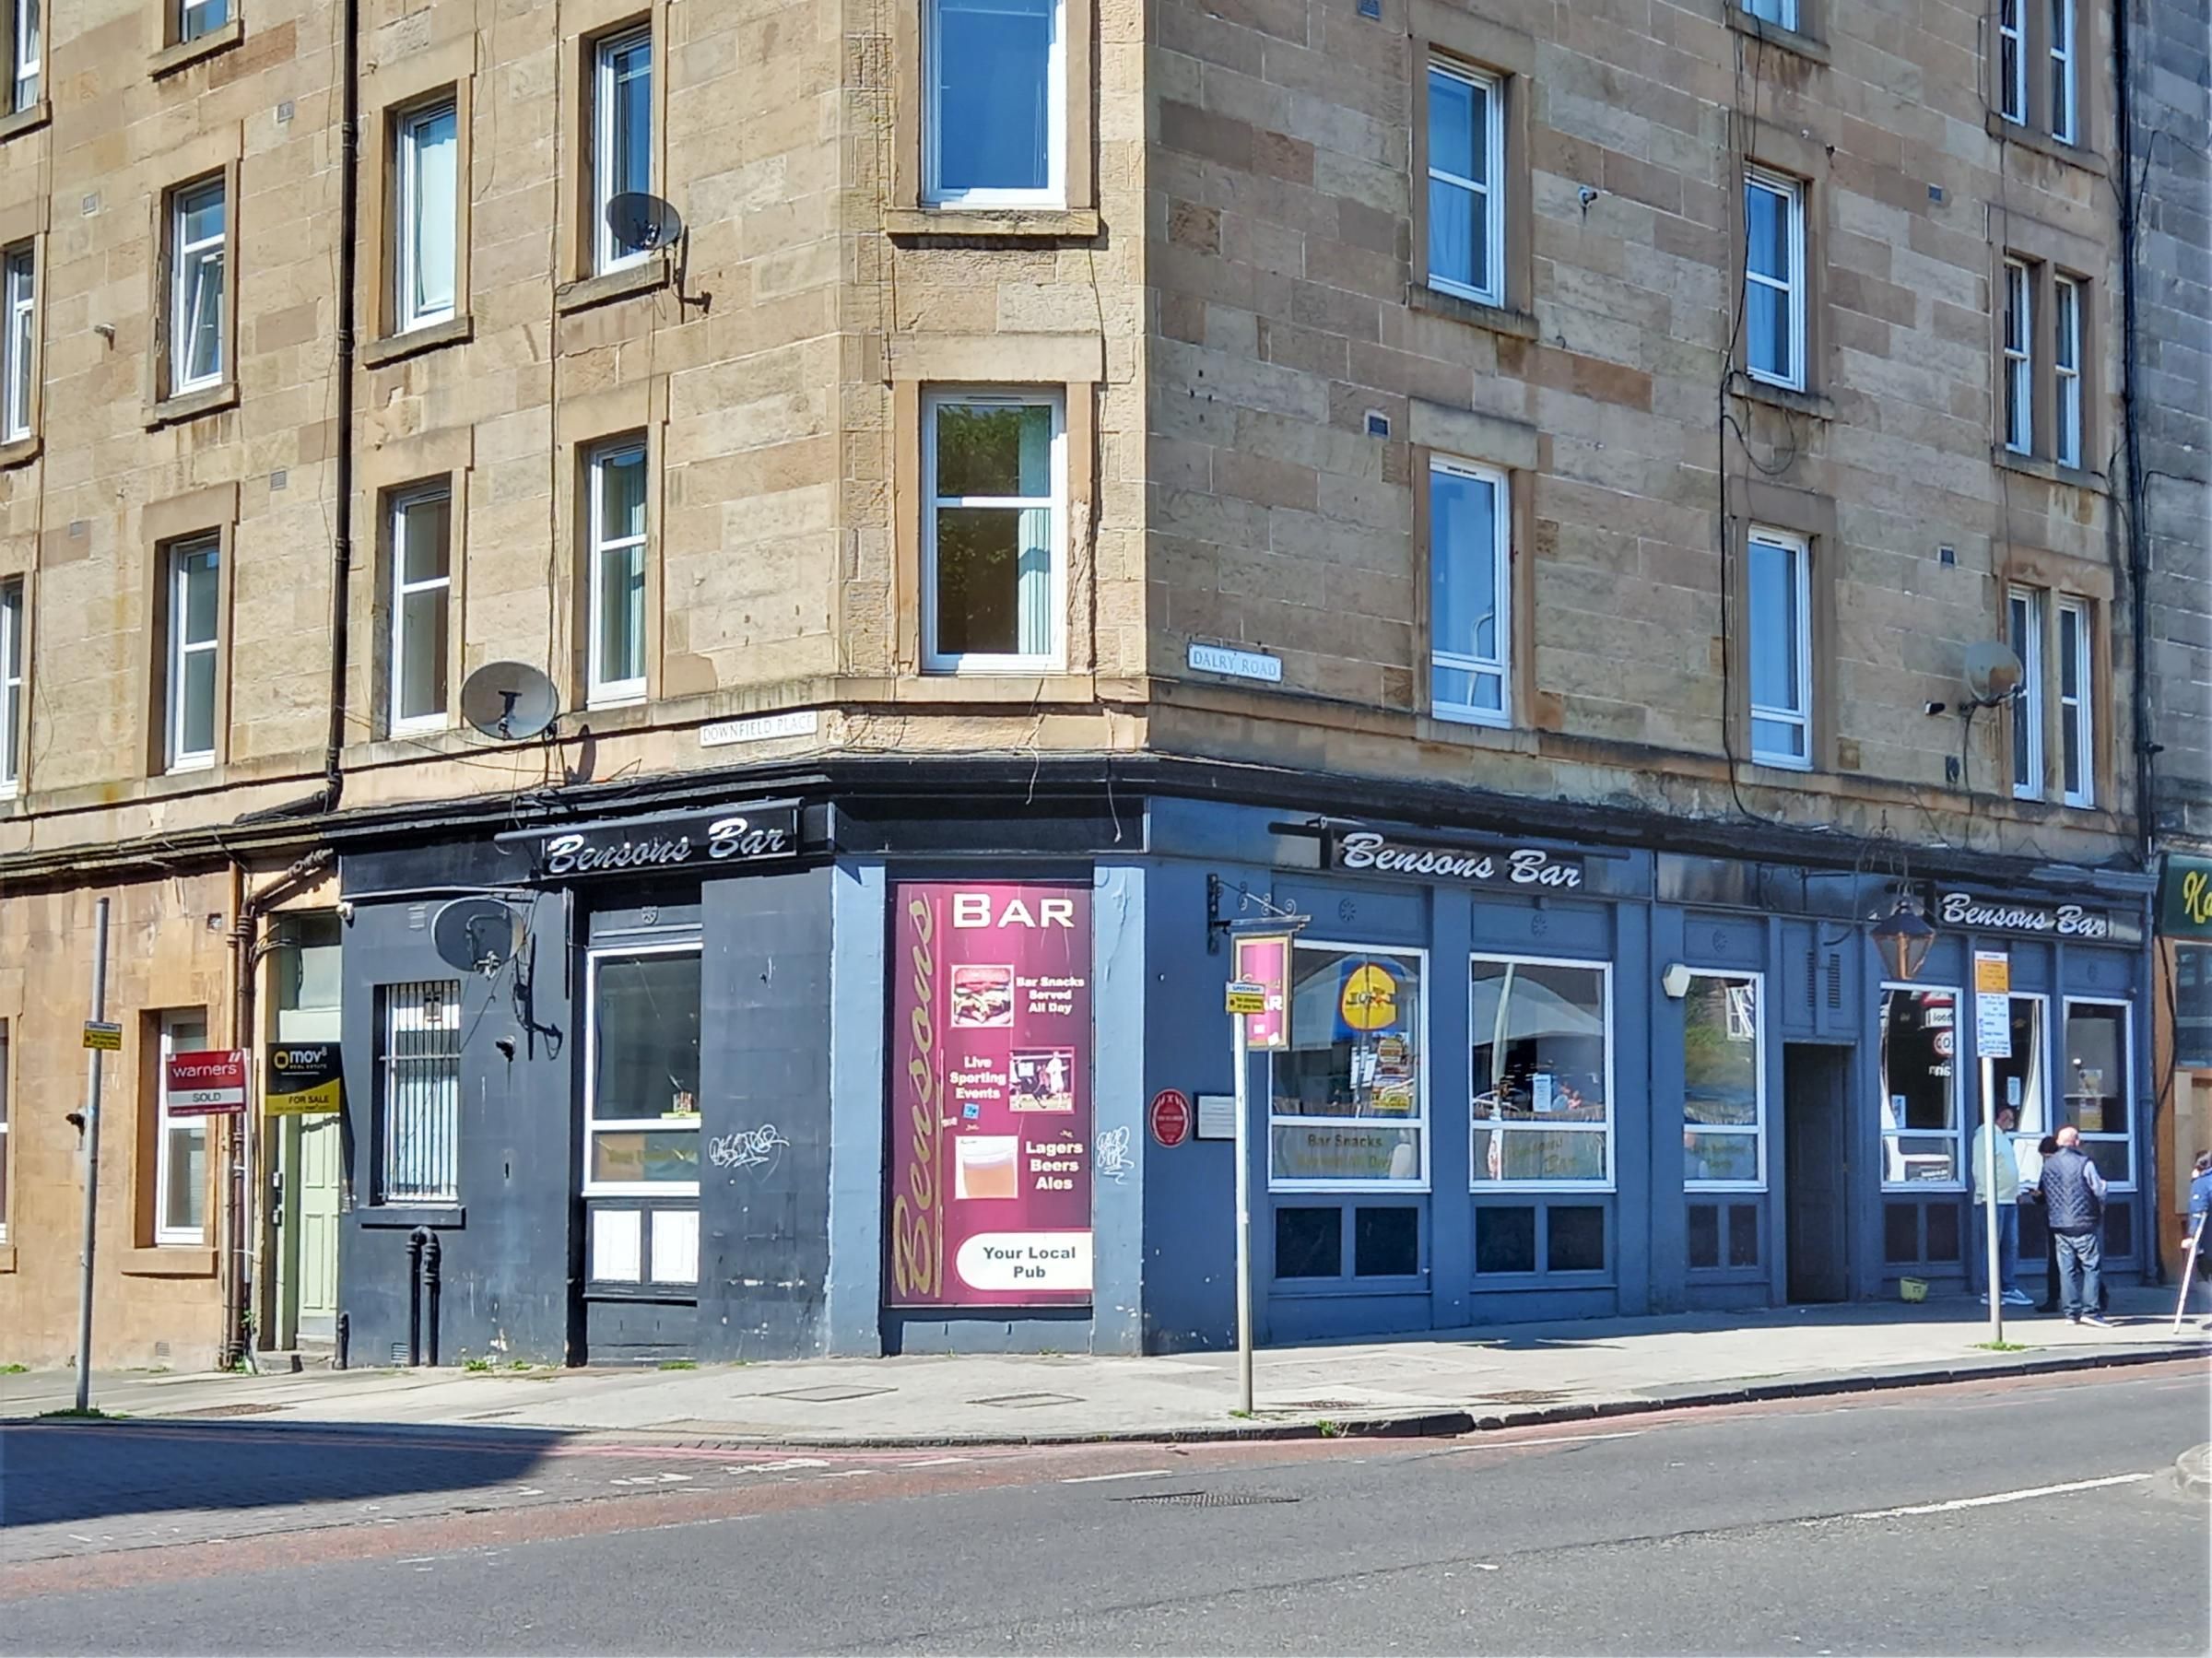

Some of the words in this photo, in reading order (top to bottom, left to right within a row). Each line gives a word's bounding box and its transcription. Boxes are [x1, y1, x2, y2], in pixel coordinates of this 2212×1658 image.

[1194, 651, 1236, 670] DALRY
[1241, 661, 1277, 676] ROAD
[703, 722, 772, 741] DOWNFIELD
[777, 714, 813, 731] PLACE
[547, 834, 692, 874] Bensons
[708, 817, 786, 858] Bar
[1341, 832, 1495, 878] Bensons
[1507, 849, 1581, 888] Bar
[953, 893, 1075, 928] BAR
[1942, 893, 2047, 932] Bensons
[2053, 904, 2107, 937] Bar
[1016, 977, 1038, 987] Bar
[1039, 977, 1085, 987] Snacks
[1029, 990, 1072, 1000] Served
[1029, 1003, 1047, 1012] All
[1048, 1003, 1073, 1015] Day
[964, 1057, 993, 1068] Live
[172, 1064, 237, 1077] warners
[949, 1072, 1006, 1086] Sporting
[193, 1092, 221, 1102] SOLD
[288, 1096, 306, 1104] FOR
[308, 1095, 329, 1103] SALE
[892, 892, 933, 1298] Bensons
[955, 1088, 1001, 1099] Events
[1025, 1141, 1084, 1156] Lagers
[1030, 1158, 1079, 1172] Beers
[1035, 1176, 1074, 1190] Ales
[982, 1246, 1023, 1260] Your
[1029, 1246, 1077, 1260] Local
[1013, 1265, 1046, 1278] Pub
